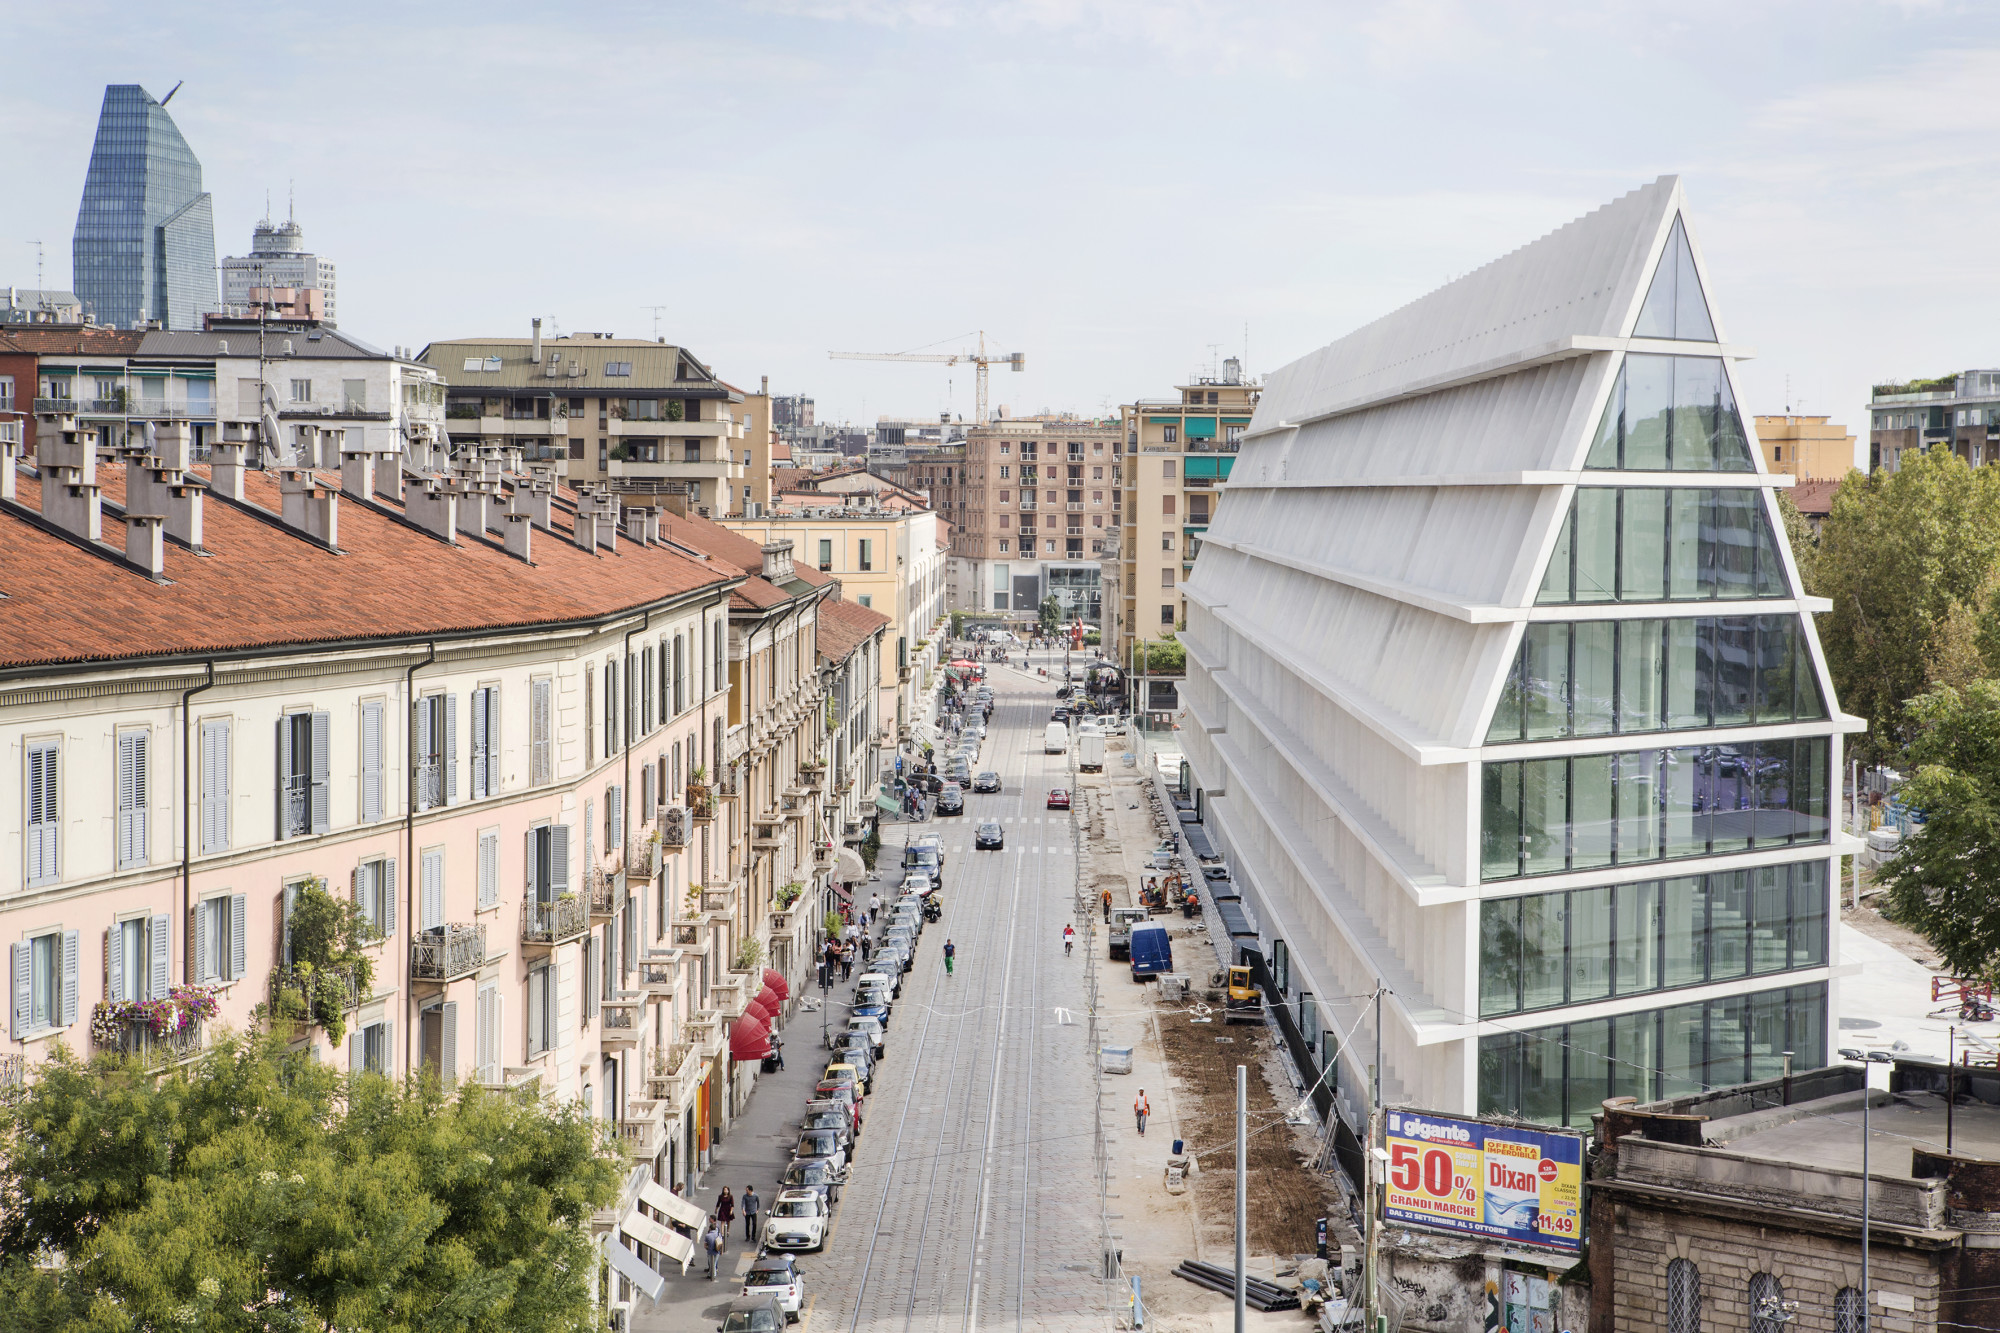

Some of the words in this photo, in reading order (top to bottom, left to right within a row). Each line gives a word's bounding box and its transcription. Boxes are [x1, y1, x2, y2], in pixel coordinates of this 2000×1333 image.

[1389, 1114, 1401, 1131] il
[1403, 1117, 1471, 1142] gigante
[1487, 1142, 1537, 1154] OFFERTA
[1487, 1147, 1537, 1160] IMPERDIBILE
[1391, 1143, 1476, 1202] 50%
[1490, 1162, 1536, 1193] Dixan
[1390, 1194, 1432, 1210] GRANDI
[1434, 1201, 1476, 1217] MARCHE
[1389, 1209, 1403, 1217] DAL
[1414, 1212, 1456, 1226] SETTEMBRE
[1474, 1224, 1508, 1235] OTTOBRE
[1538, 1214, 1573, 1232] 11,49
